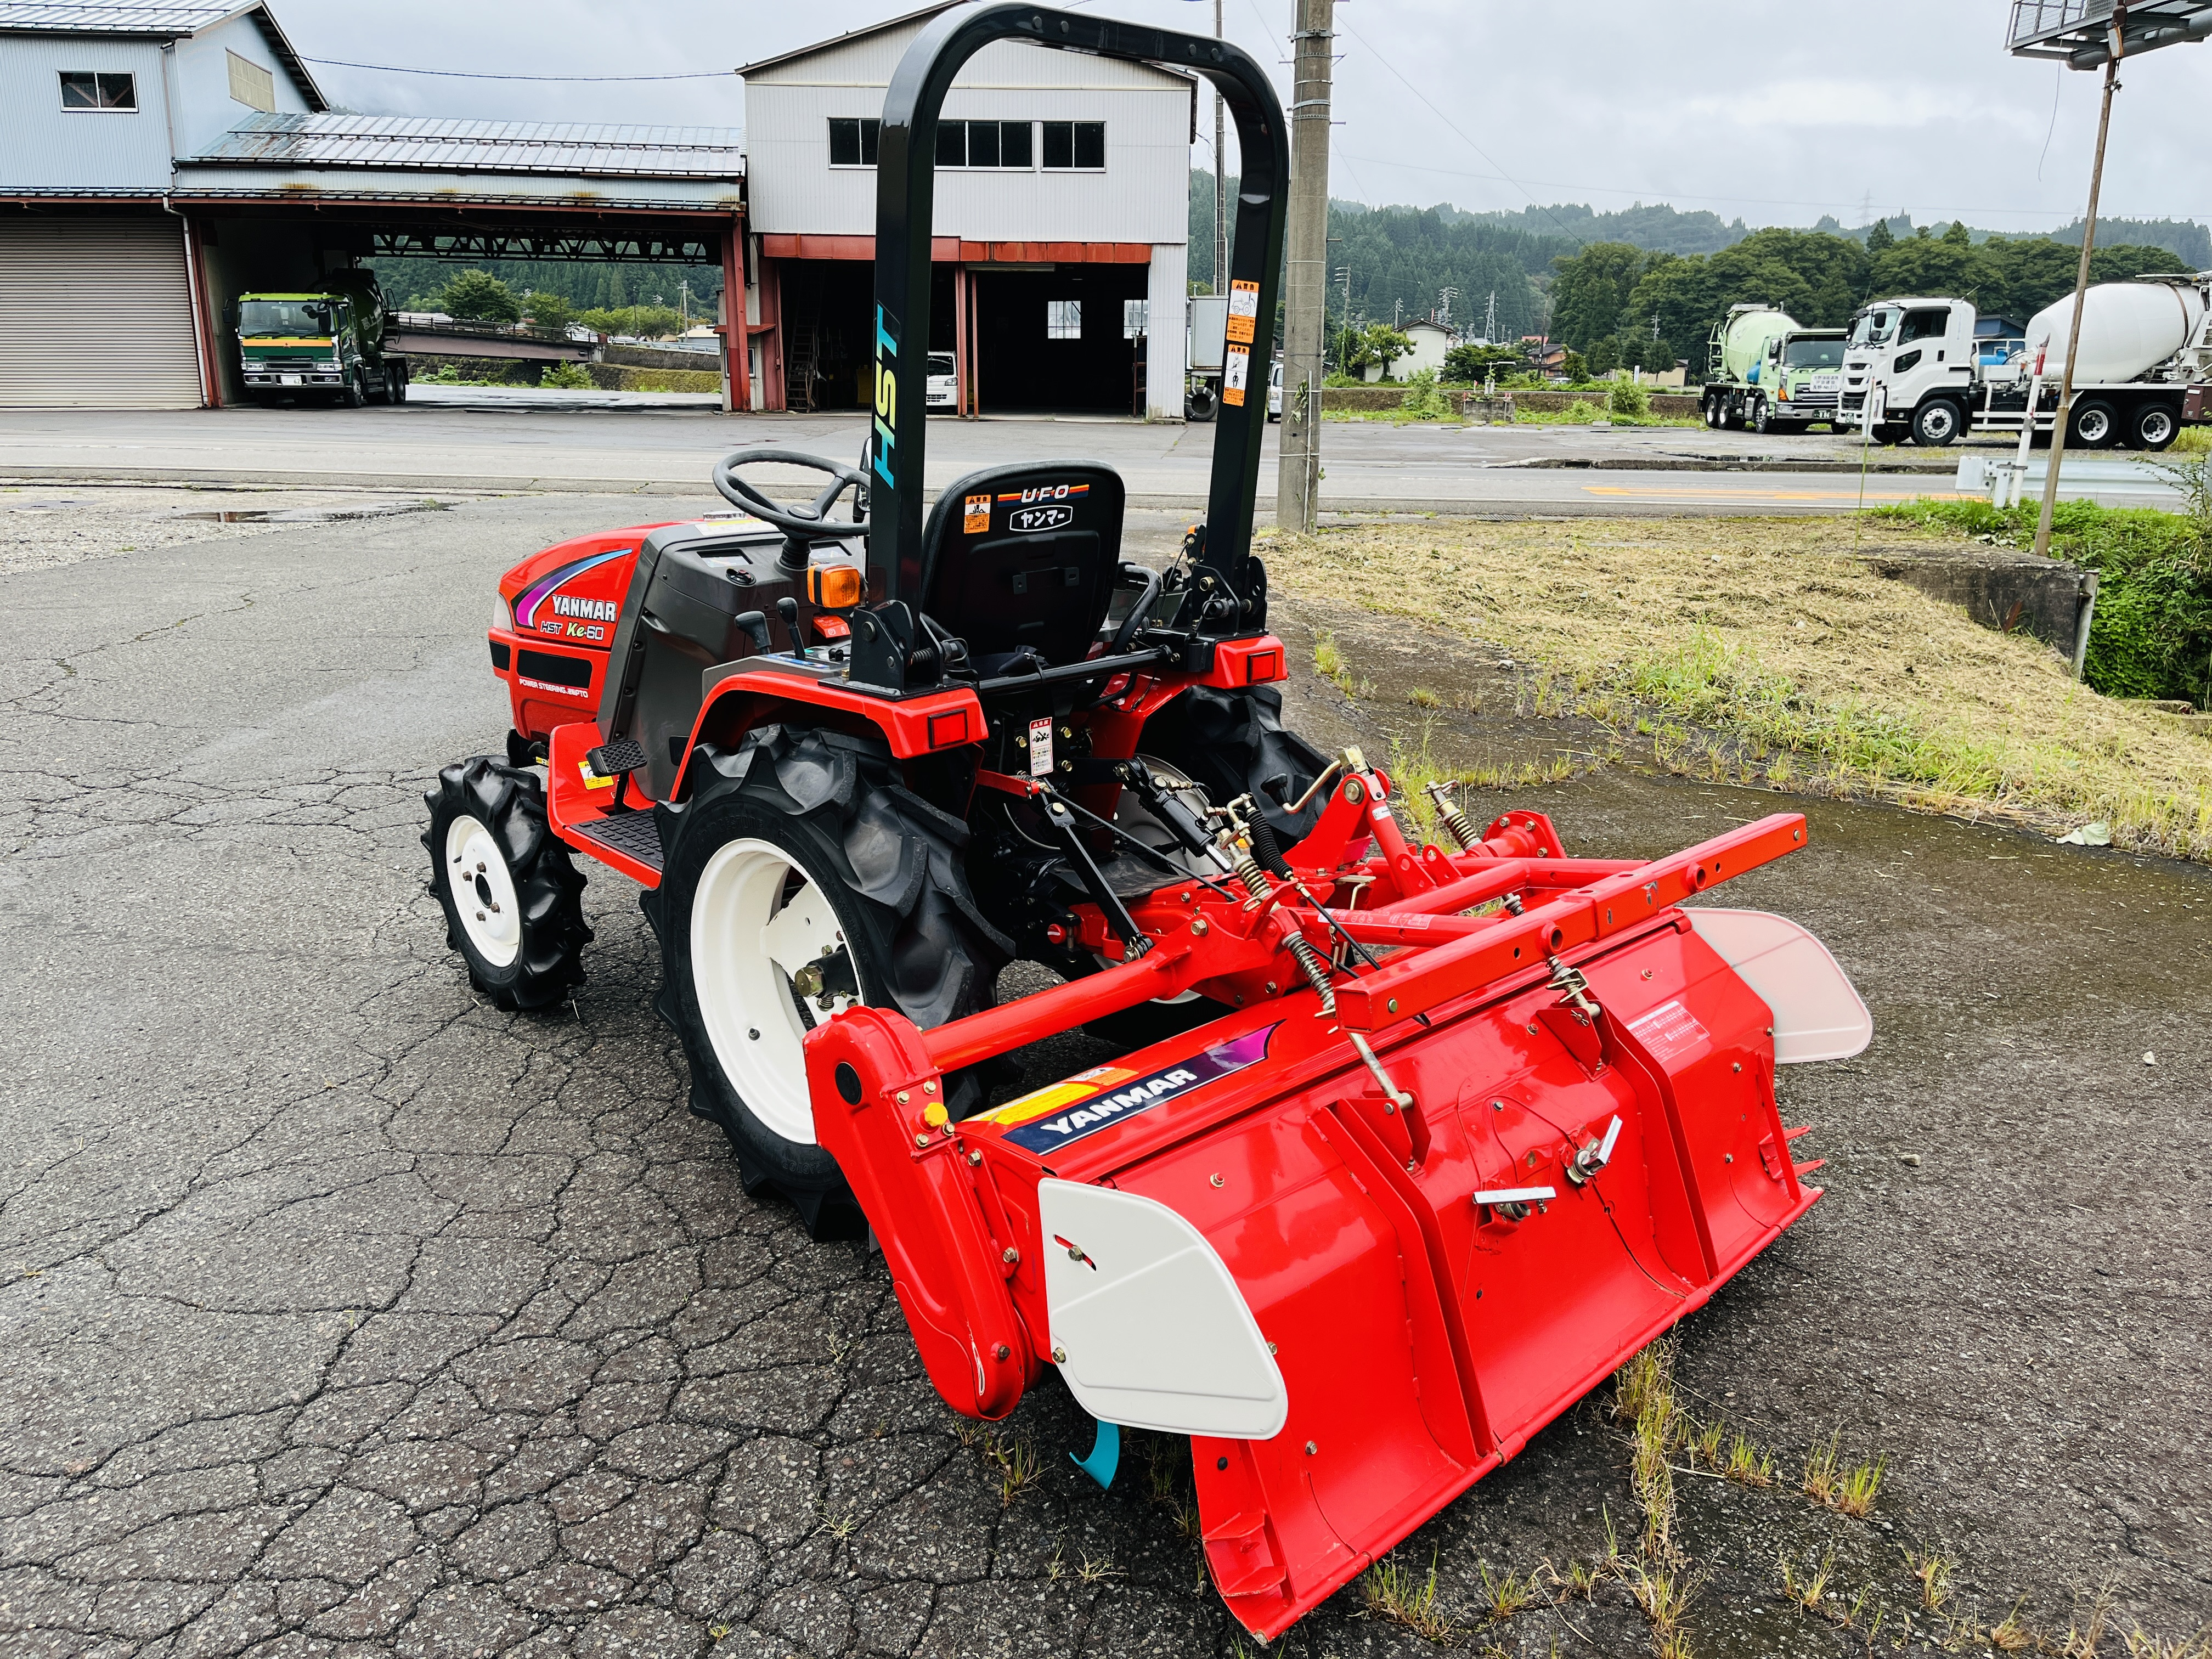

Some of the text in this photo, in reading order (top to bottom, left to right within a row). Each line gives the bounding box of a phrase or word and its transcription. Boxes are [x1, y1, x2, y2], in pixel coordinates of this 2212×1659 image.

[874, 303, 898, 490] HST
[1020, 484, 1069, 503] UFO
[1020, 509, 1065, 529] ヤンマー
[551, 594, 617, 623] YANMAR
[540, 620, 605, 641] HST Ke-60
[518, 678, 539, 689] POWER
[1040, 1068, 1198, 1135] YANMAR
